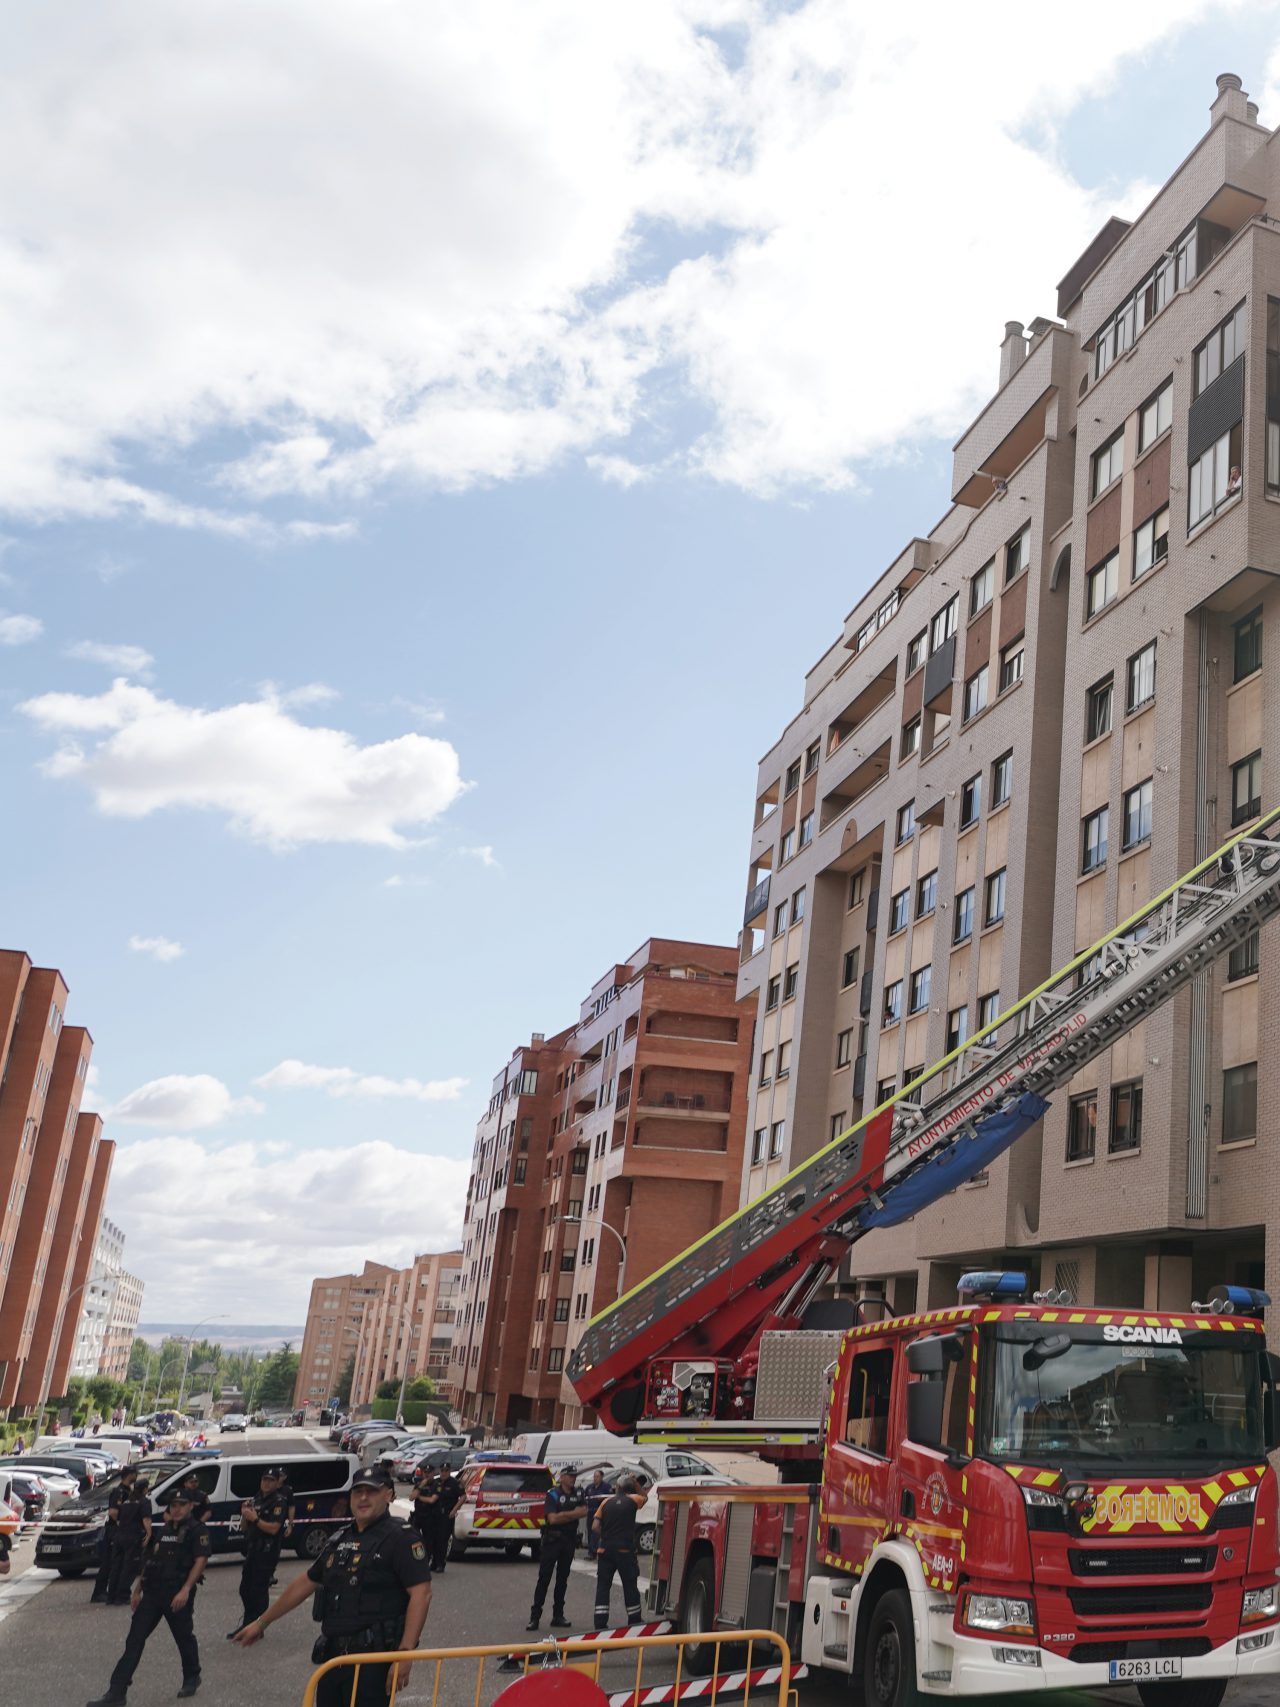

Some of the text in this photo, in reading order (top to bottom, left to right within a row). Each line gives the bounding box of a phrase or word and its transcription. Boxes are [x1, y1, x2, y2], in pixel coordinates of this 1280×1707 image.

[907, 1087, 994, 1157] AYUNTAMIENTO
[996, 1071, 1016, 1088] DE
[1103, 1325, 1183, 1344] SCANIA
[851, 1473, 870, 1506] 112
[932, 1553, 953, 1573] AEA-9
[1043, 1633, 1076, 1642] P 320
[1118, 1660, 1179, 1677] 6263 LCL
